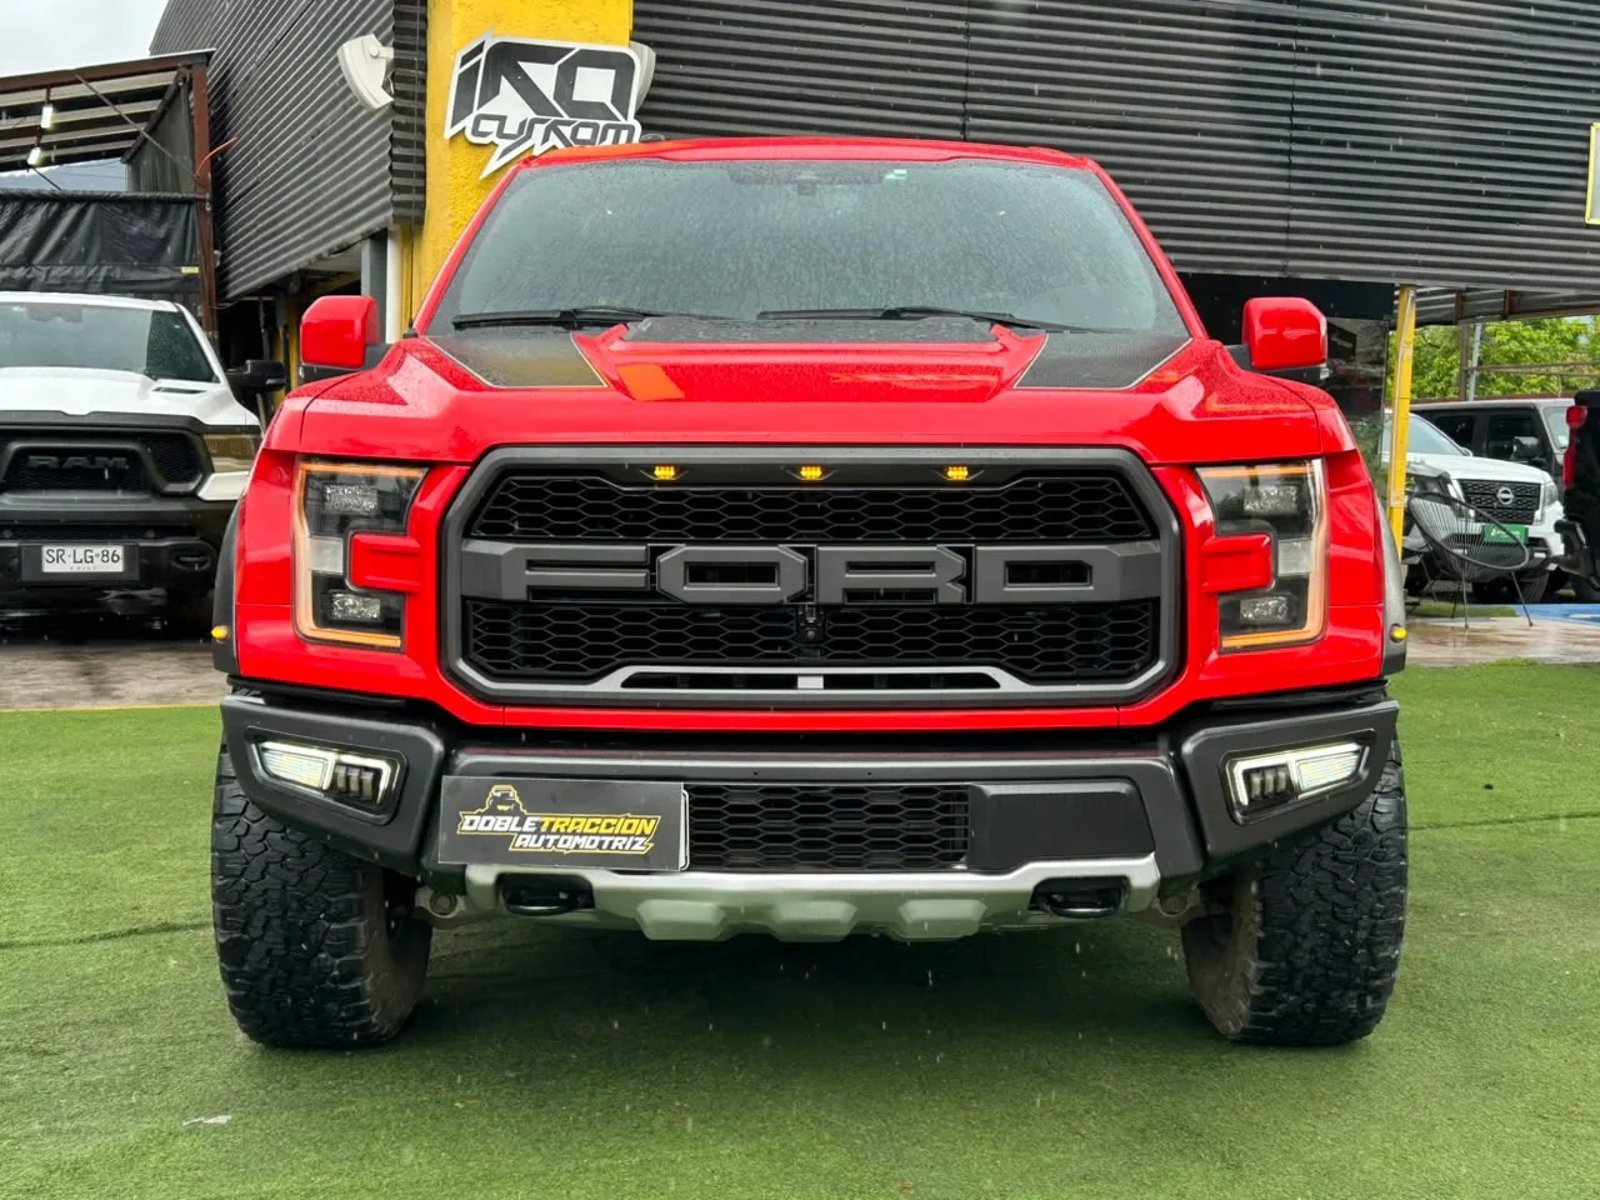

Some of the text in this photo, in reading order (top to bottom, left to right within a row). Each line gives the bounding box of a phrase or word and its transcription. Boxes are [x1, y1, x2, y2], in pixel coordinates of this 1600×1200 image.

[28, 456, 127, 469] RAM
[462, 541, 1161, 604] FORD
[515, 834, 647, 850] AUTOMOTRIZ
